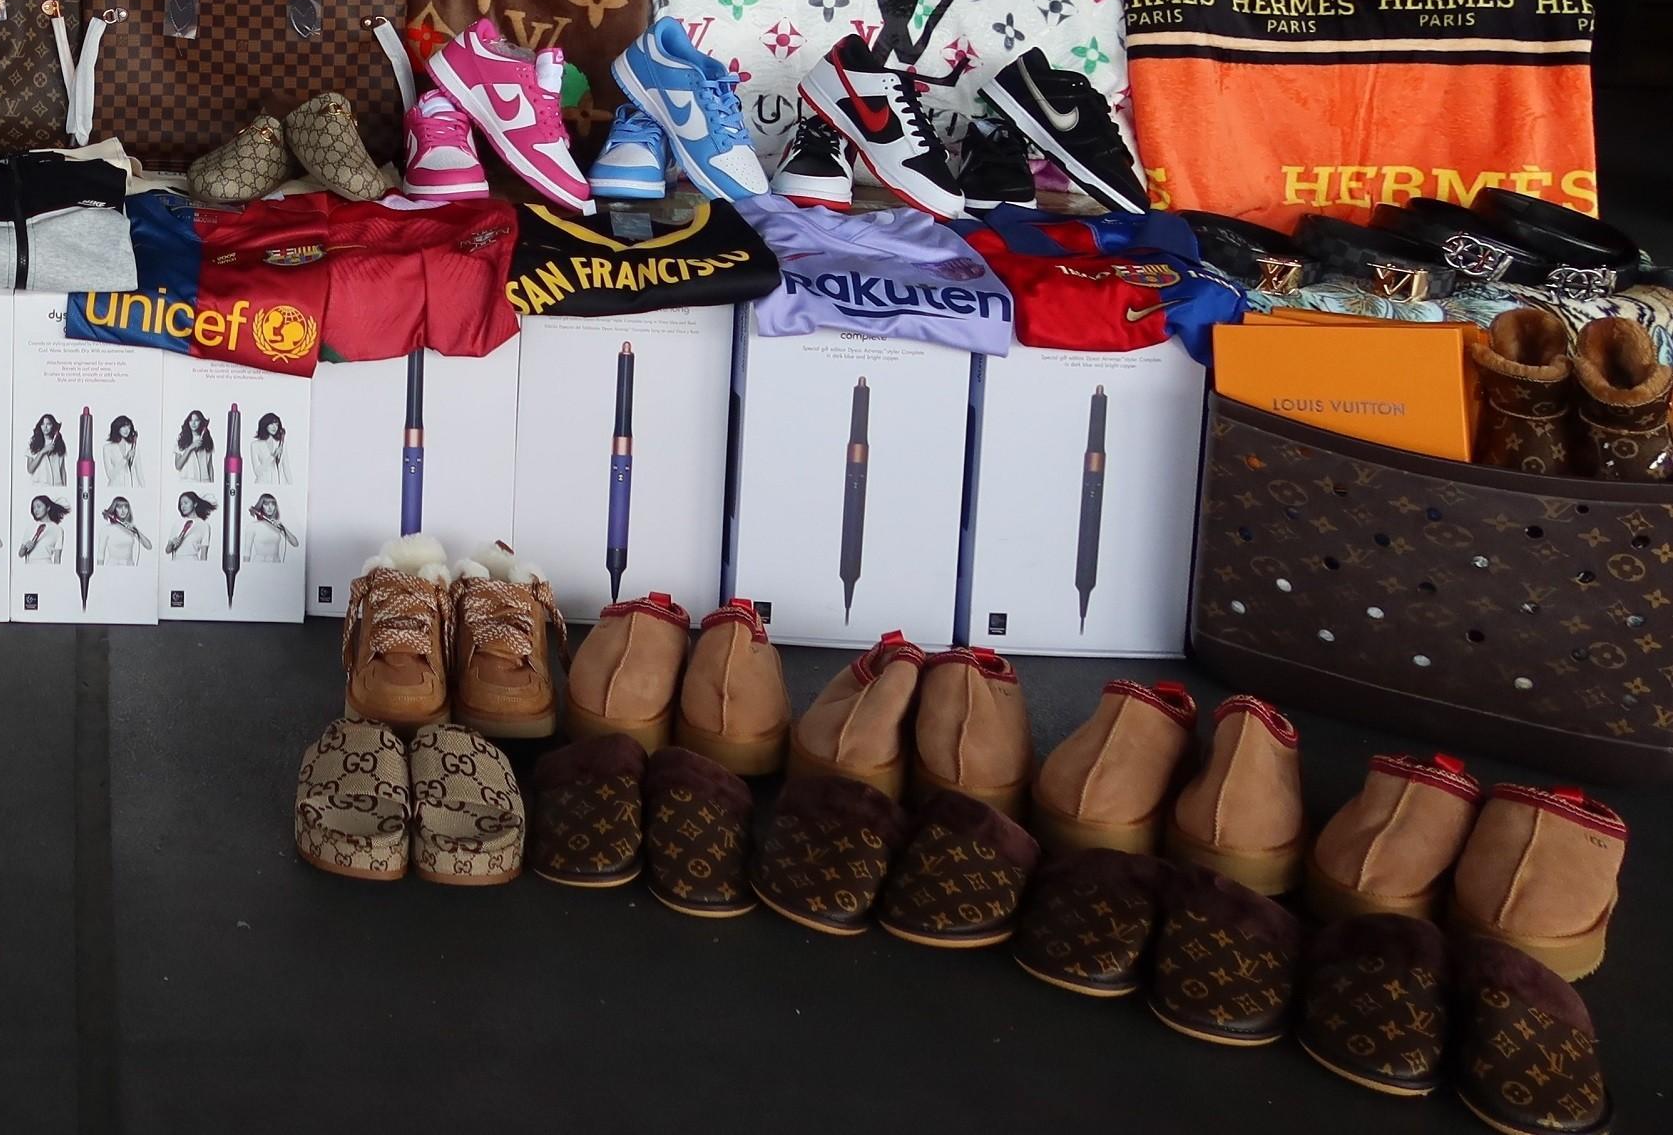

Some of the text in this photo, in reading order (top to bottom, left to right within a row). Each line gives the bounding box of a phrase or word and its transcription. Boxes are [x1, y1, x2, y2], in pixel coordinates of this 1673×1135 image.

[1127, 8, 1184, 26] PARIS
[1266, 19, 1317, 33] PARIS
[1419, 12, 1476, 28] PARIS
[1281, 165, 1599, 220] HERMÈS
[505, 250, 750, 316] SAN FRANCISCO
[785, 271, 1014, 322] Rakuten
[48, 309, 68, 322] dys
[85, 286, 250, 352] unicef
[1272, 398, 1405, 416] LOUIS VUITTON
